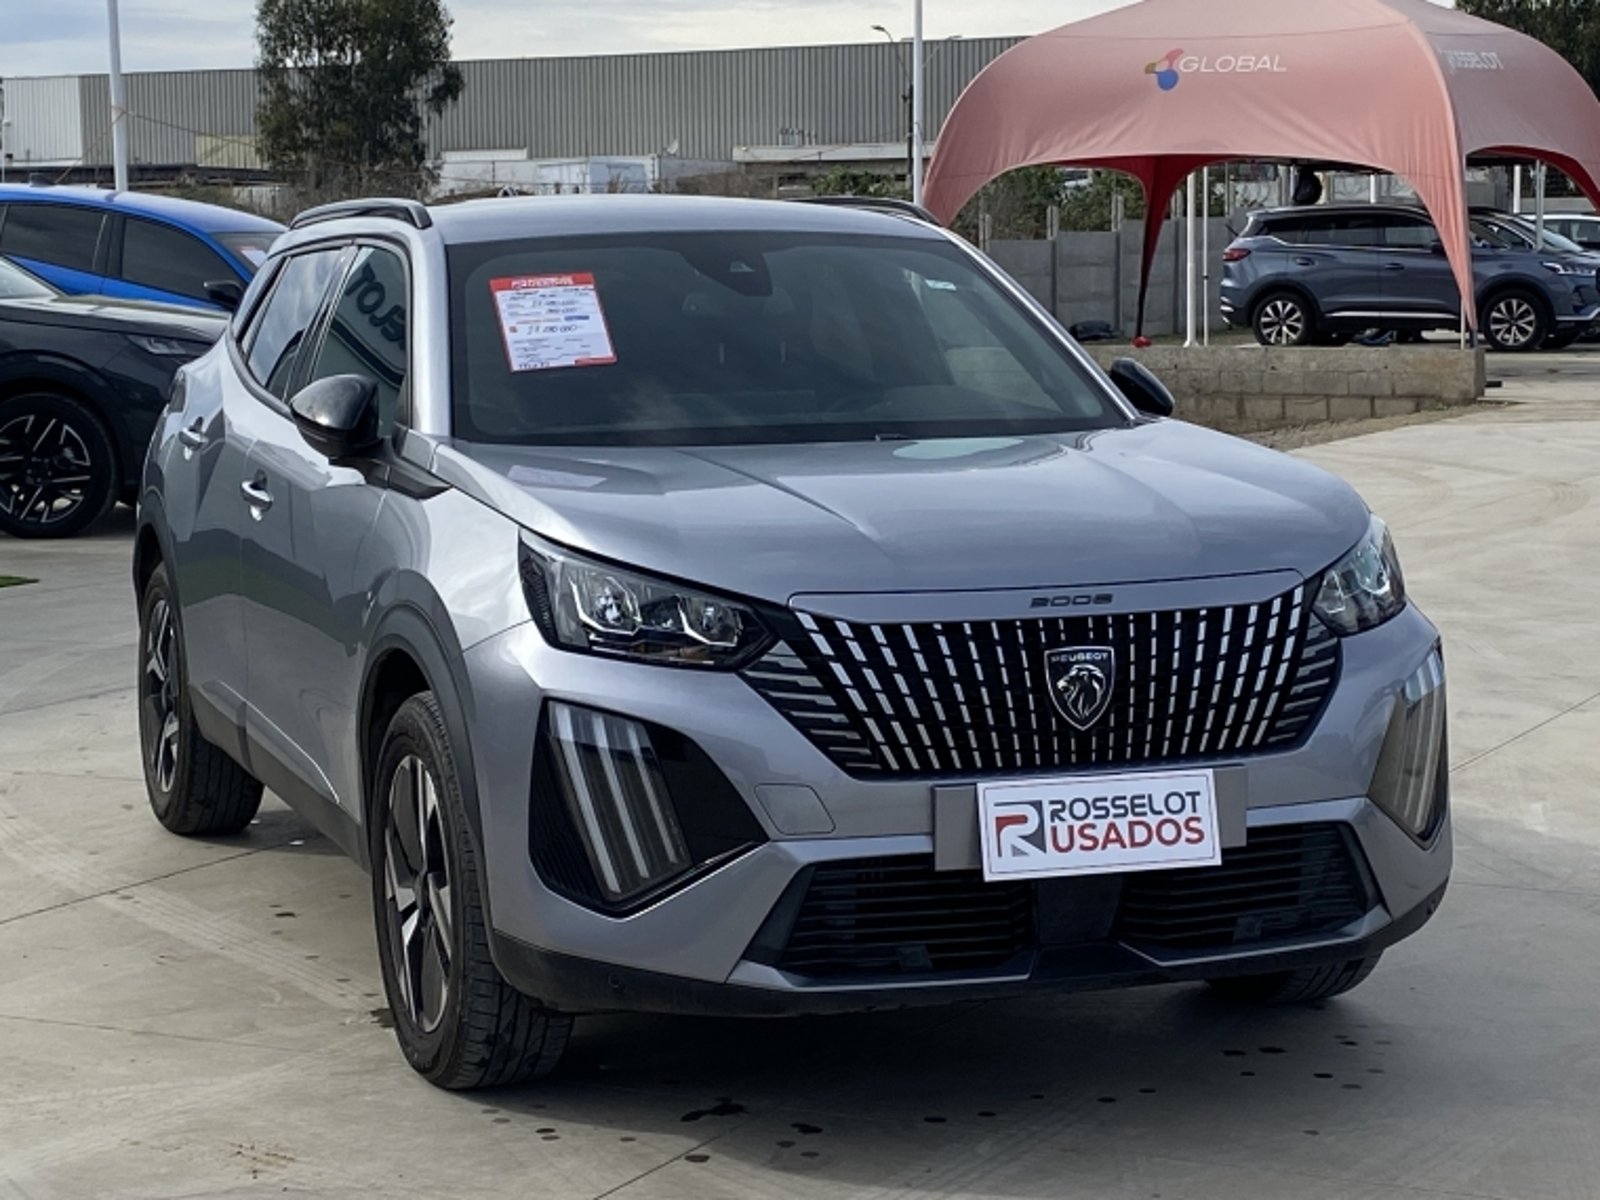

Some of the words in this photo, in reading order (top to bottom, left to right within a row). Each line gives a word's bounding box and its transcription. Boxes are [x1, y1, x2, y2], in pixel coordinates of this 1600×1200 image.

[1179, 54, 1288, 73] GLOBAL
[1050, 651, 1110, 663] PEUGEOT
[1048, 790, 1202, 824] ROSSELOT
[1050, 816, 1206, 854] USADOS
